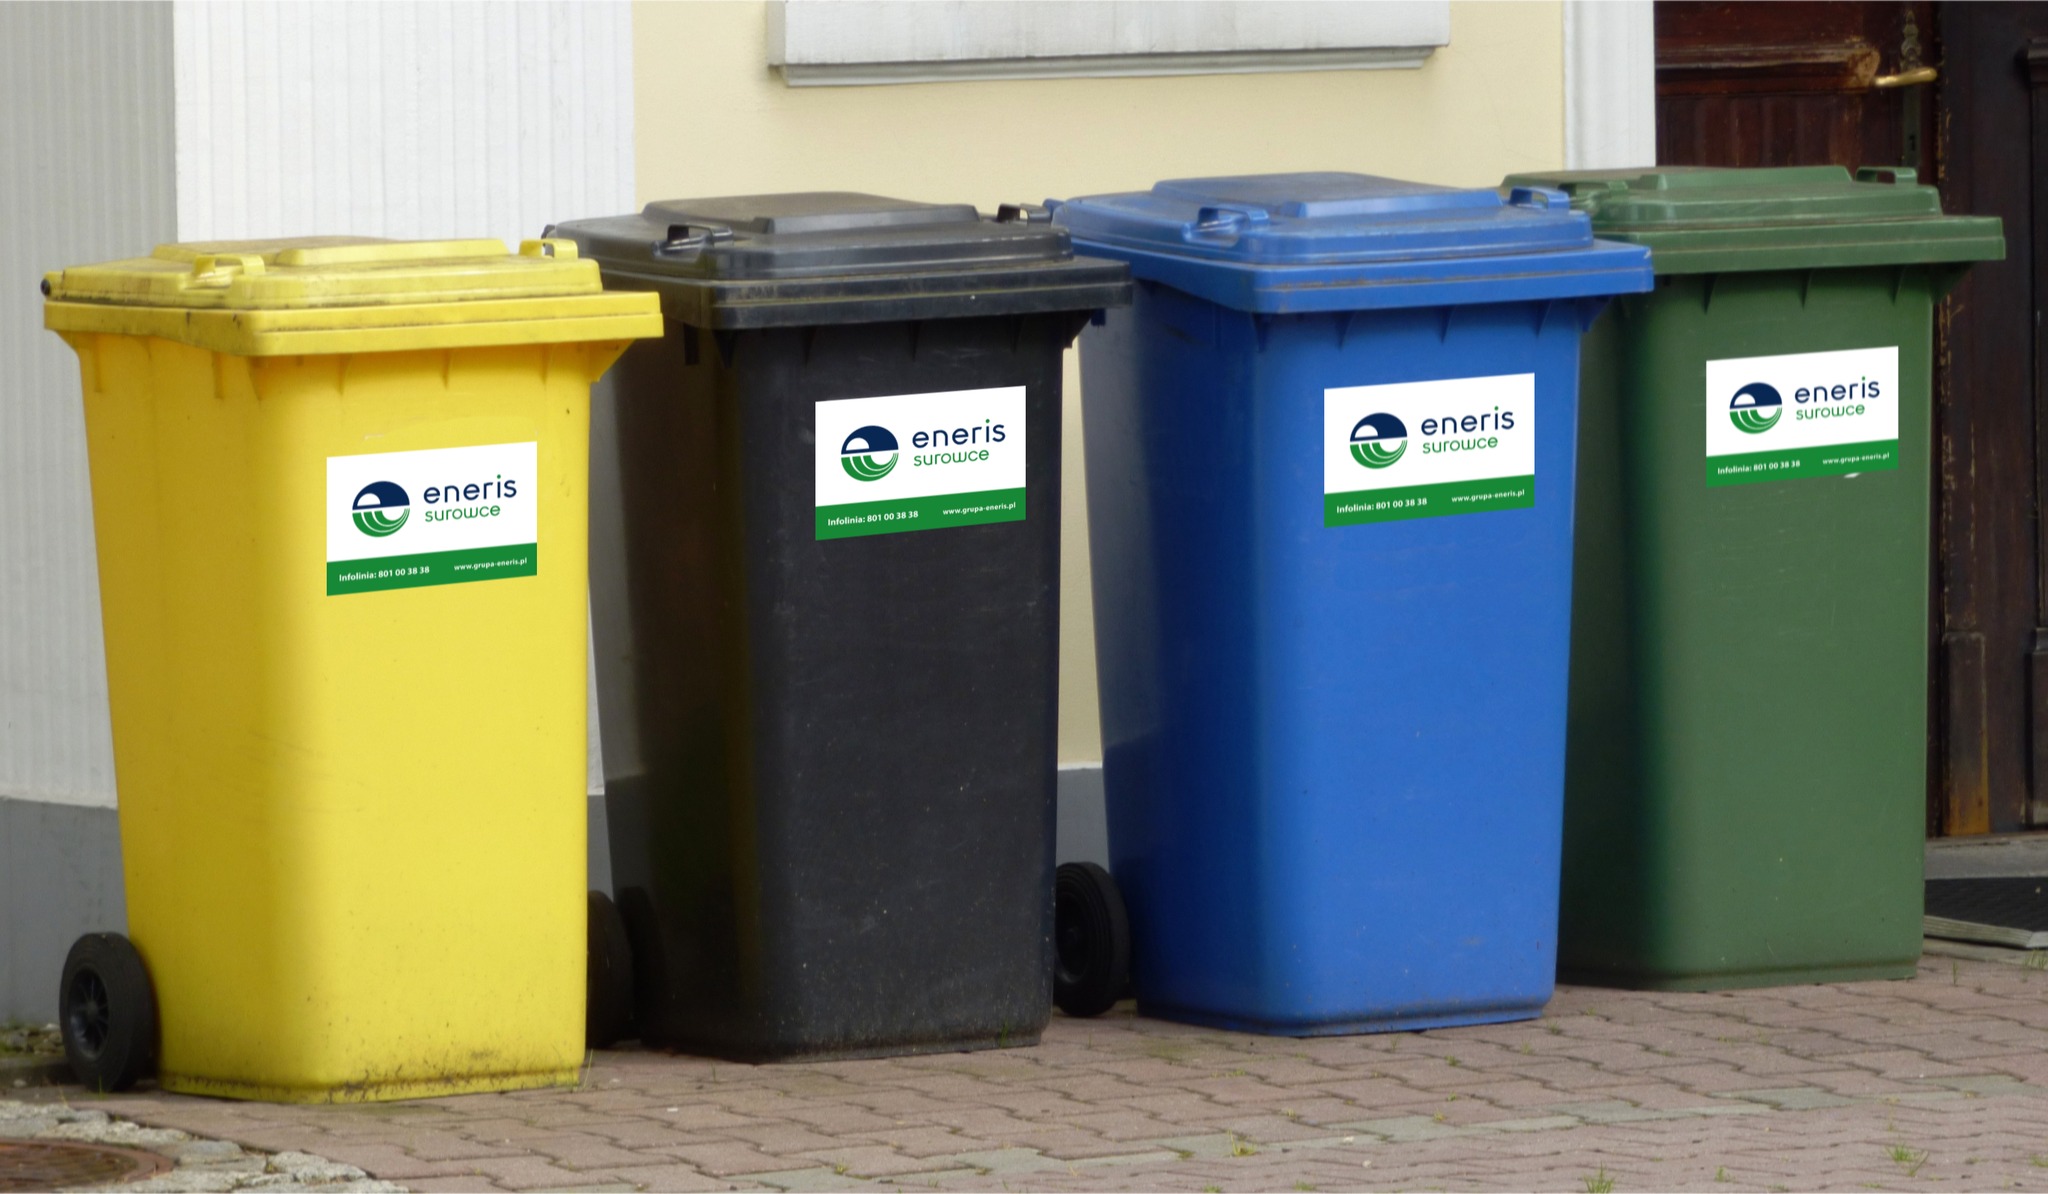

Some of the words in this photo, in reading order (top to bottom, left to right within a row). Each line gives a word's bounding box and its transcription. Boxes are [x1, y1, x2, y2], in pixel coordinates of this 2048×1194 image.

[1794, 376, 1880, 403] eneris
[1796, 404, 1865, 420] surowce
[1421, 406, 1514, 436] eneris
[912, 419, 1006, 448] eneris
[1422, 437, 1498, 454] surowce
[913, 450, 989, 467] surowce
[423, 474, 517, 504] eneris
[1451, 489, 1525, 502] www.grupa-eneris.pl
[425, 505, 500, 522] surowce
[942, 502, 1016, 515] www.grupa-eneris.pl
[1336, 505, 1374, 514] Infolinia:
[1393, 500, 1403, 508] 00
[1405, 499, 1415, 507] 38
[1417, 498, 1427, 506] 38
[828, 517, 865, 526] Infolinia:
[867, 514, 882, 522] 801
[884, 513, 894, 521] 00
[896, 512, 906, 520] 38
[454, 557, 527, 571] www.grupa-eneris.pl
[339, 573, 377, 582] Infolinia:
[378, 570, 393, 578] 801
[407, 567, 418, 575] 38
[419, 566, 430, 574] 38
